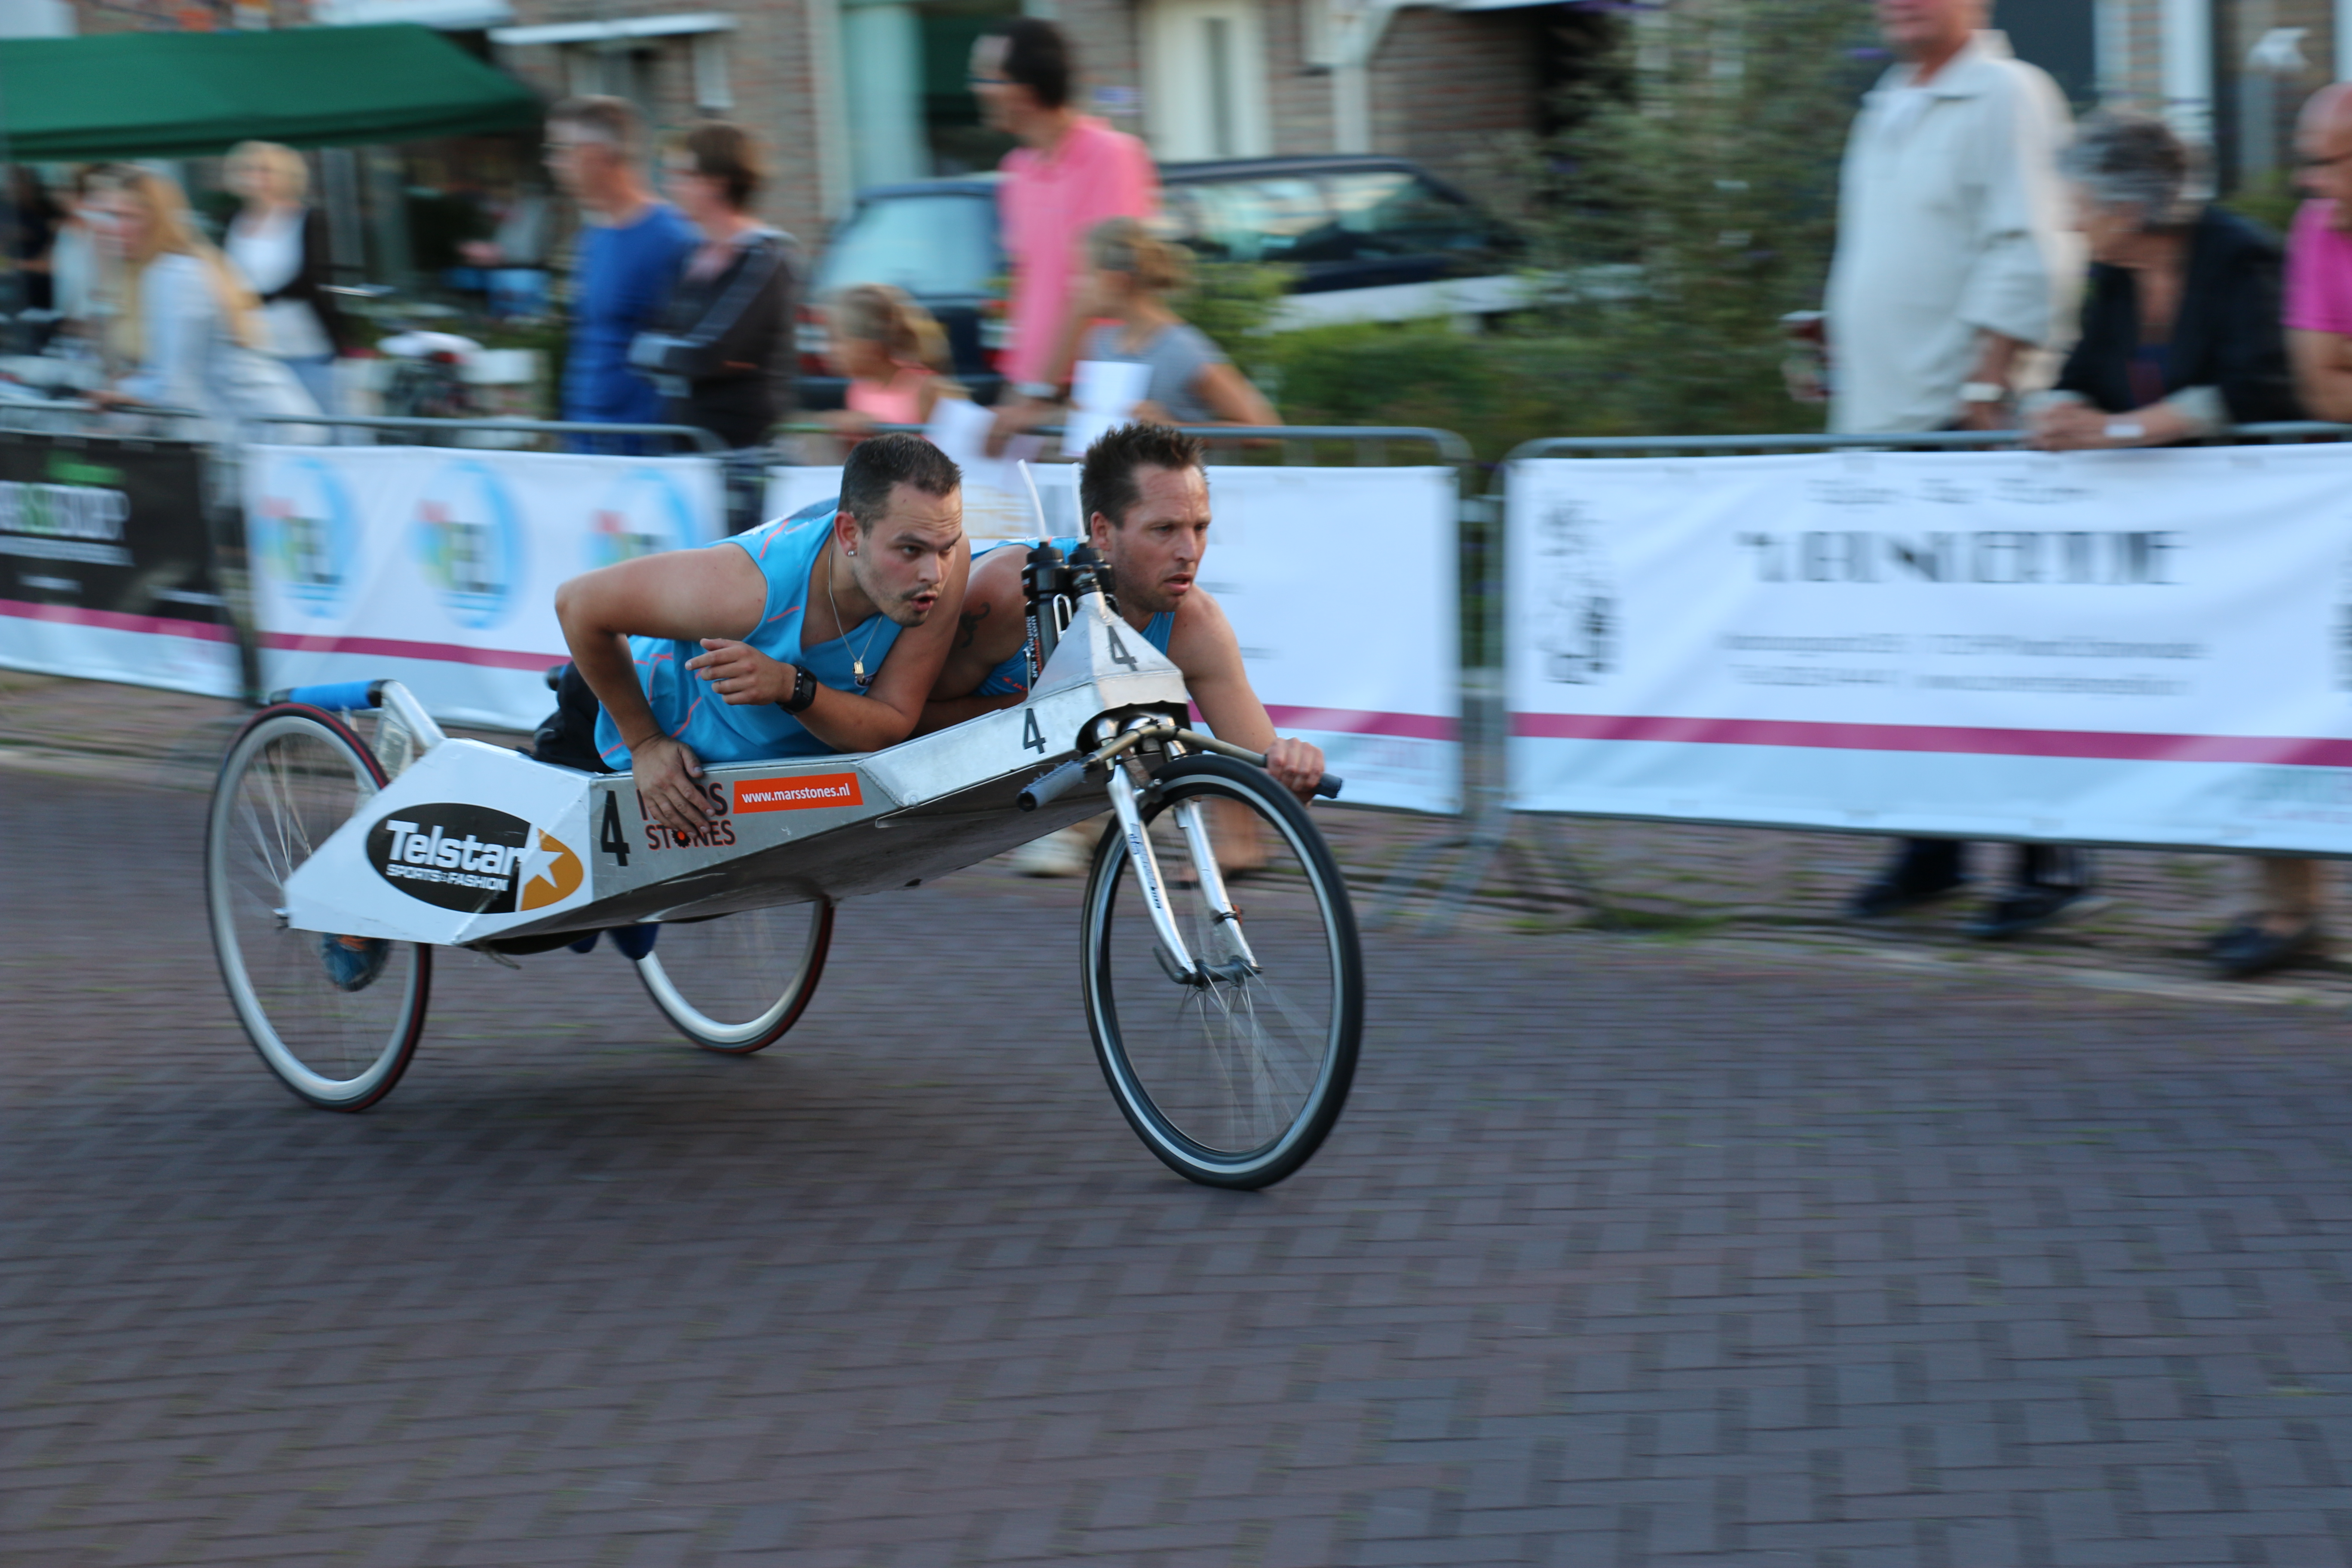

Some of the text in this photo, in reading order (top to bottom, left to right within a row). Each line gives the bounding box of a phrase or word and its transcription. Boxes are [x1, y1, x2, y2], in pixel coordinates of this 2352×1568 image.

[1108, 626, 1137, 671] 4
[1023, 708, 1047, 754] 4
[741, 783, 850, 803] www.marsstones.nl
[386, 820, 524, 876] Telstar
[600, 790, 630, 866] 4
